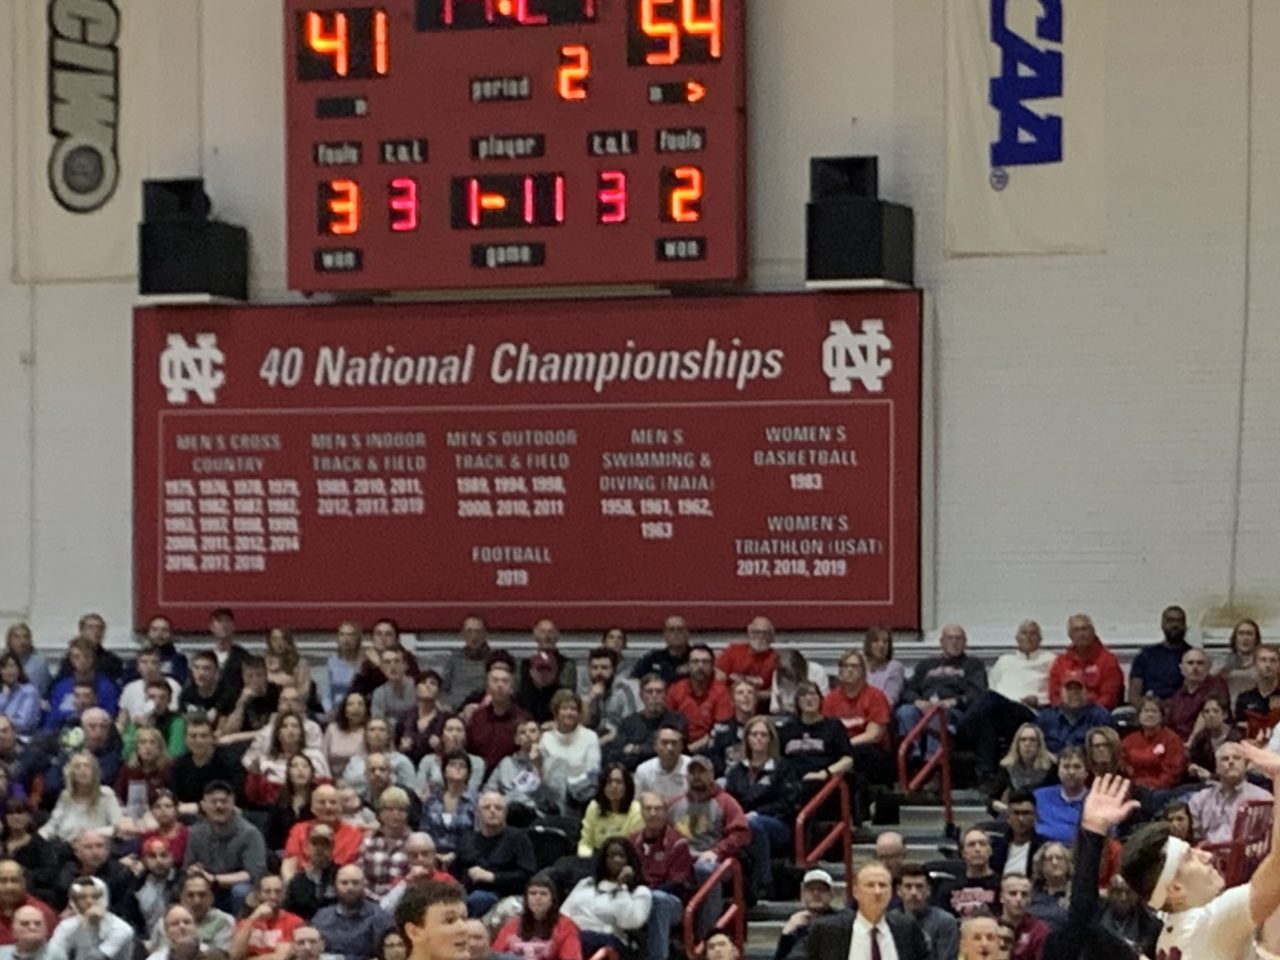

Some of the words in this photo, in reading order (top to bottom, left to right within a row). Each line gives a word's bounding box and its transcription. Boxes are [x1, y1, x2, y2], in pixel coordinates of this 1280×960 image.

[306, 10, 391, 77] 41
[641, 0, 722, 66] 54
[557, 44, 591, 101] 2
[329, 178, 362, 236] 3
[388, 176, 419, 232] 3
[598, 169, 627, 224] 3
[670, 166, 704, 223] 2
[259, 346, 304, 387] 40
[313, 343, 476, 387] National
[490, 336, 784, 393] Championships
[384, 455, 427, 472] FIELD
[526, 452, 570, 470] FIELD
[599, 475, 657, 492] DIVING
[602, 452, 695, 469] SWIMMING
[753, 450, 858, 467] BASKETBALL
[472, 546, 552, 563] FOOTBALL
[734, 538, 824, 555] TRIATHLON
